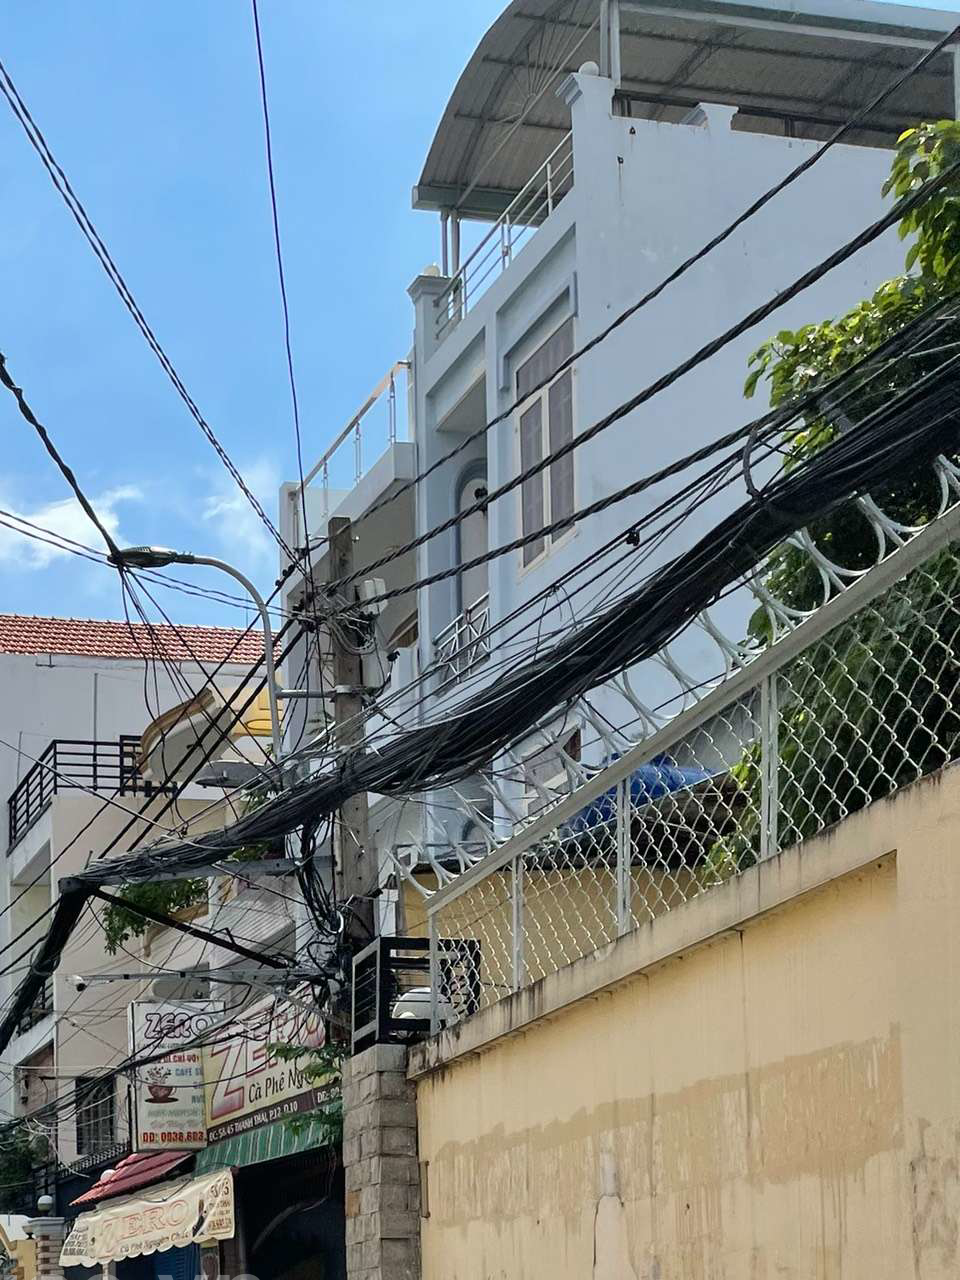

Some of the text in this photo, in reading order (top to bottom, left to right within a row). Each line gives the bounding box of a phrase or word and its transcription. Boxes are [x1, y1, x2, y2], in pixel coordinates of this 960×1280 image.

[144, 1012, 214, 1040] ZERO
[248, 1082, 262, 1103] Cà
[265, 1071, 285, 1098] Phê
[98, 1199, 190, 1260] ZERO
